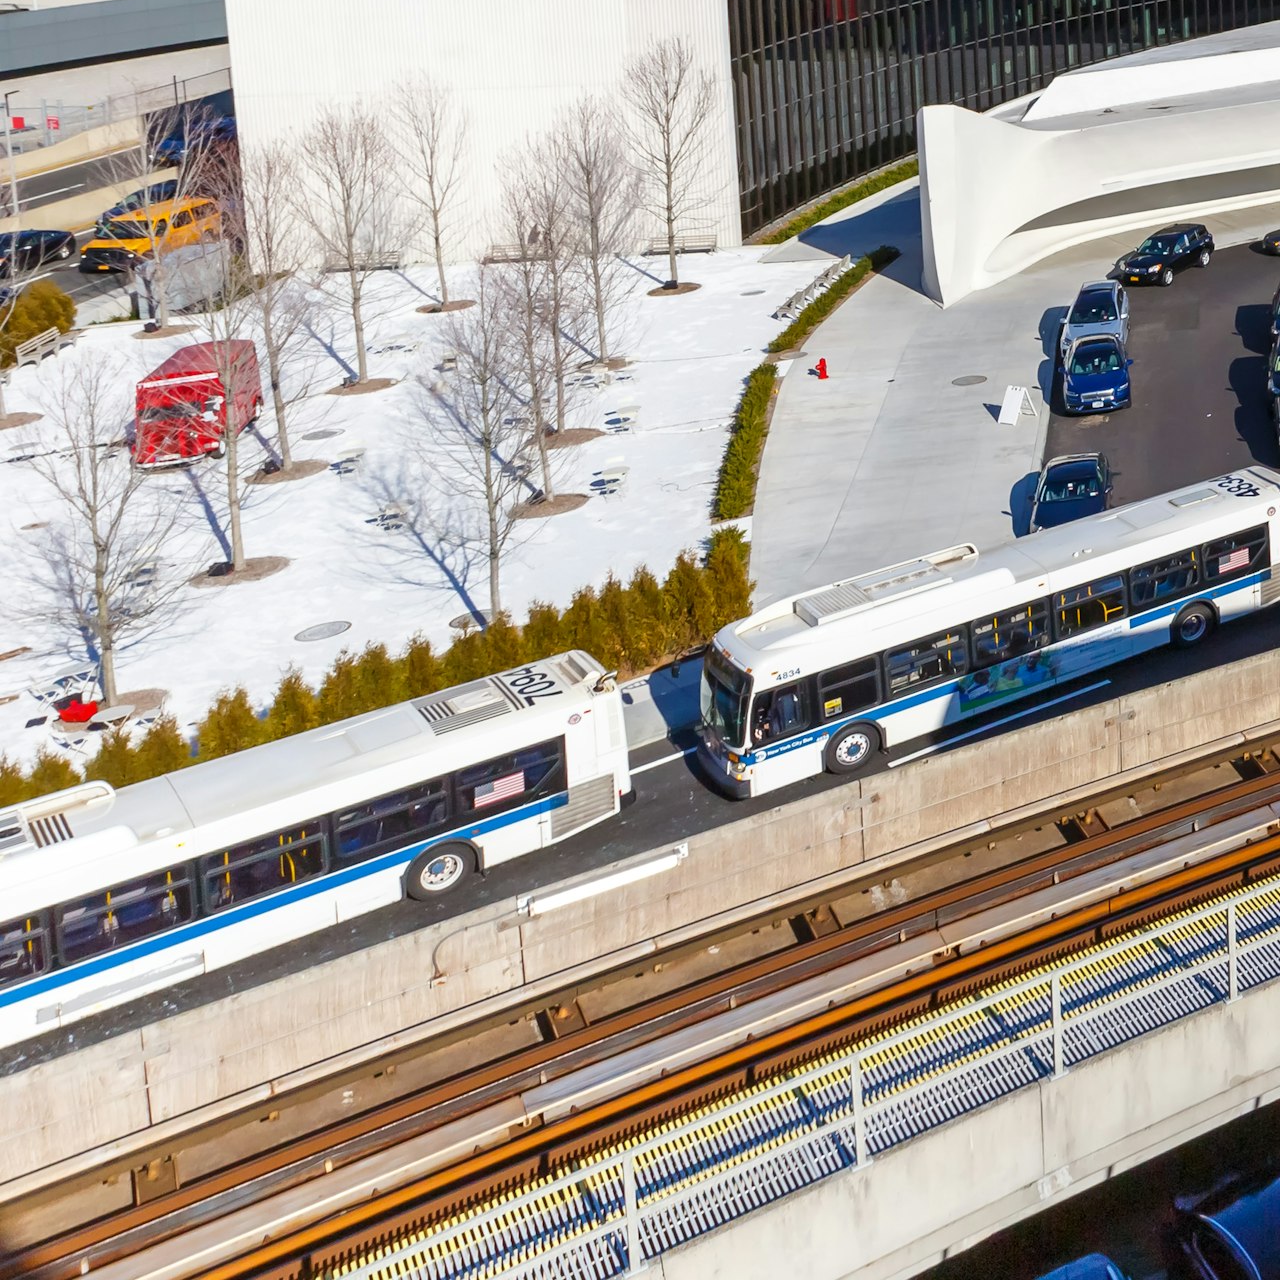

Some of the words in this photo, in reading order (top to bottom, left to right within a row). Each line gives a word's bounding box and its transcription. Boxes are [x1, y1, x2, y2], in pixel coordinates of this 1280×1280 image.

[1208, 474, 1260, 497] 4834
[776, 667, 801, 681] 4834
[502, 665, 563, 707] 7094
